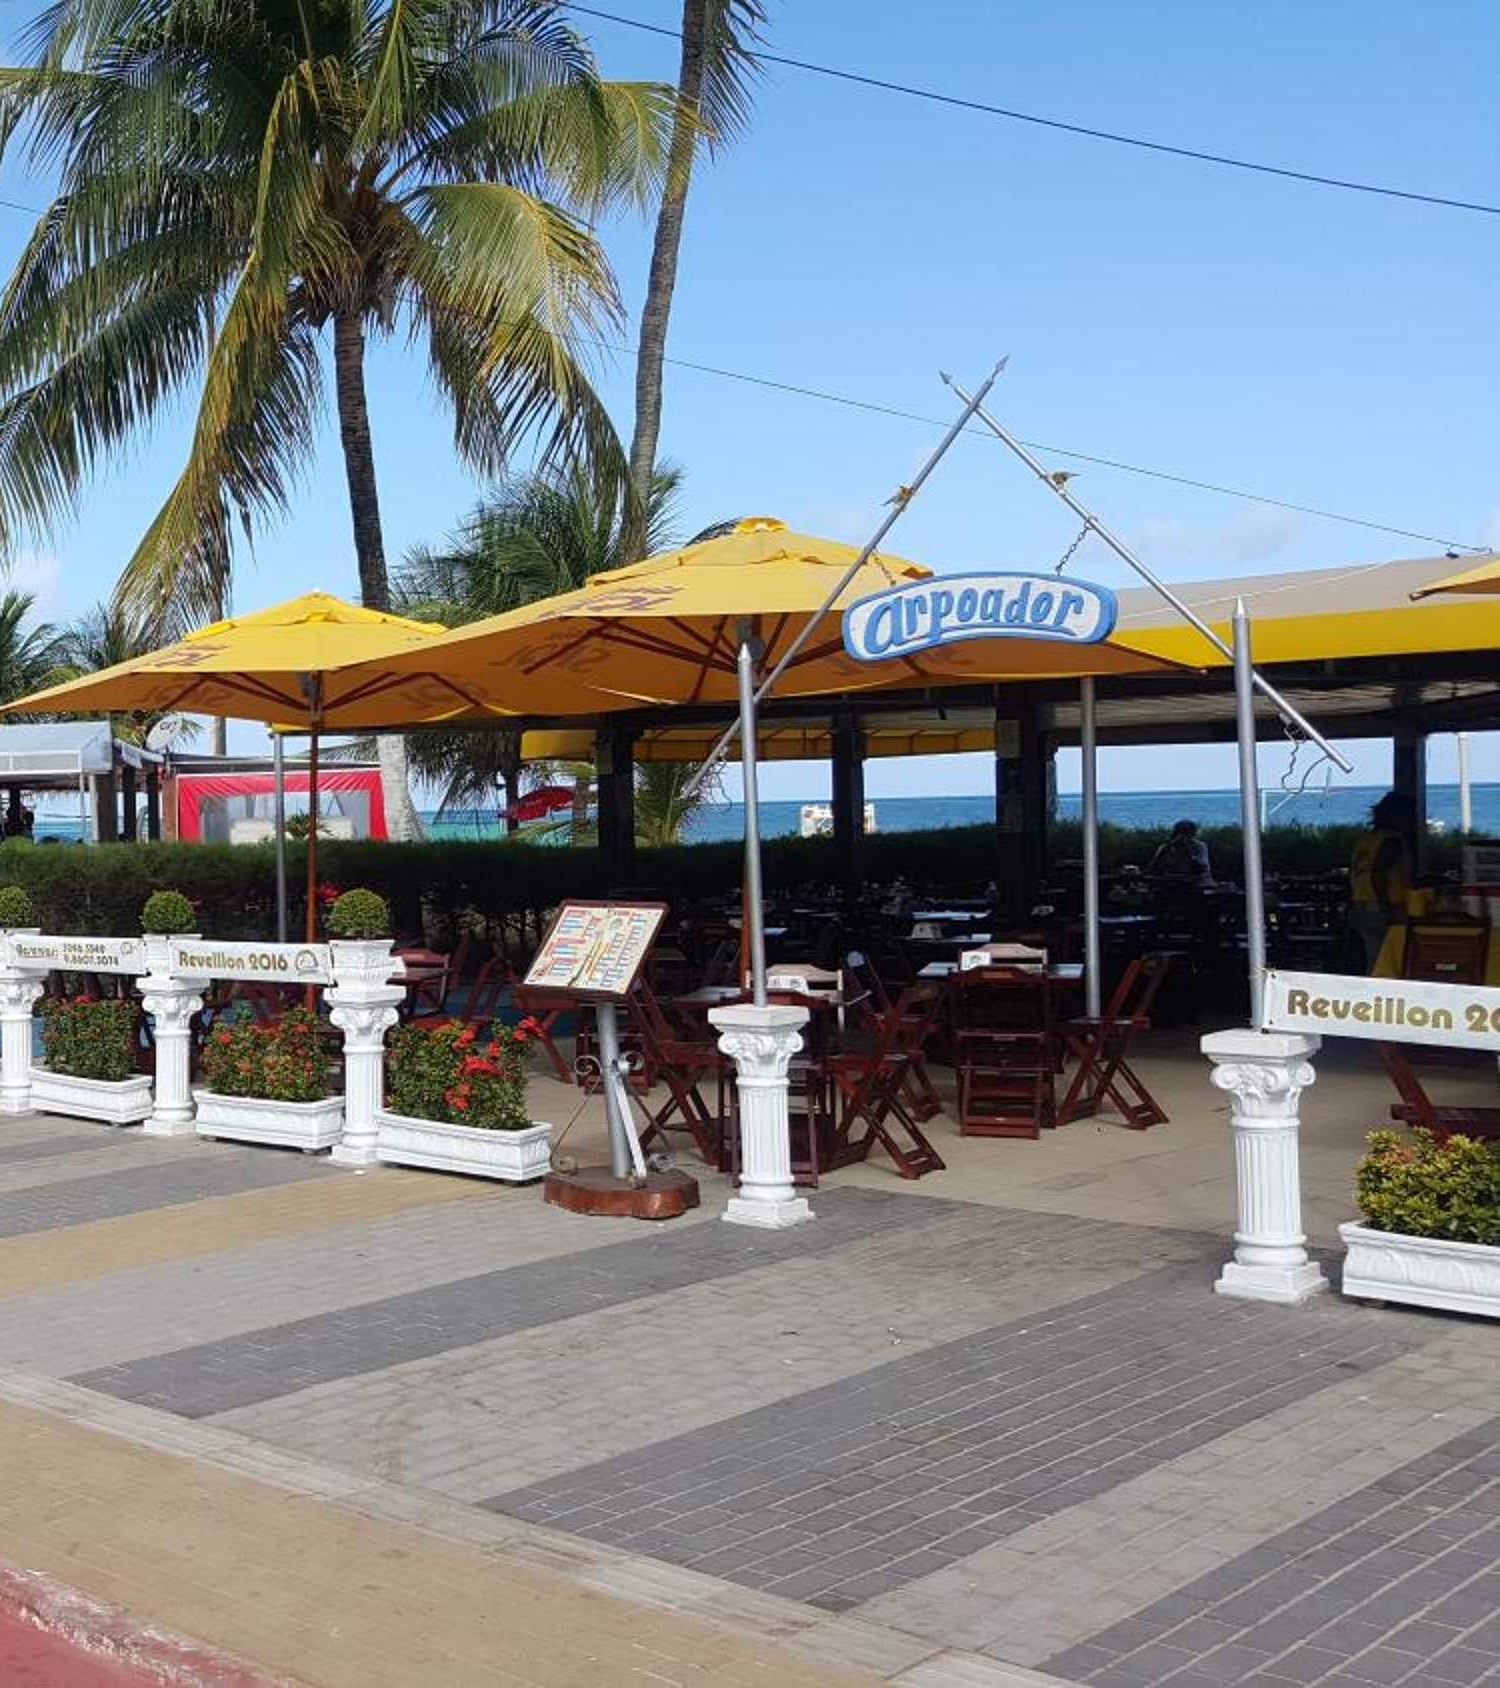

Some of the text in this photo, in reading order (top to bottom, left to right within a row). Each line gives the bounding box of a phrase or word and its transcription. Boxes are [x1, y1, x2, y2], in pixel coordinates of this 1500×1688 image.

[179, 951, 289, 972] Reveillon 2016
[1287, 989, 1453, 1030] Reveillon
